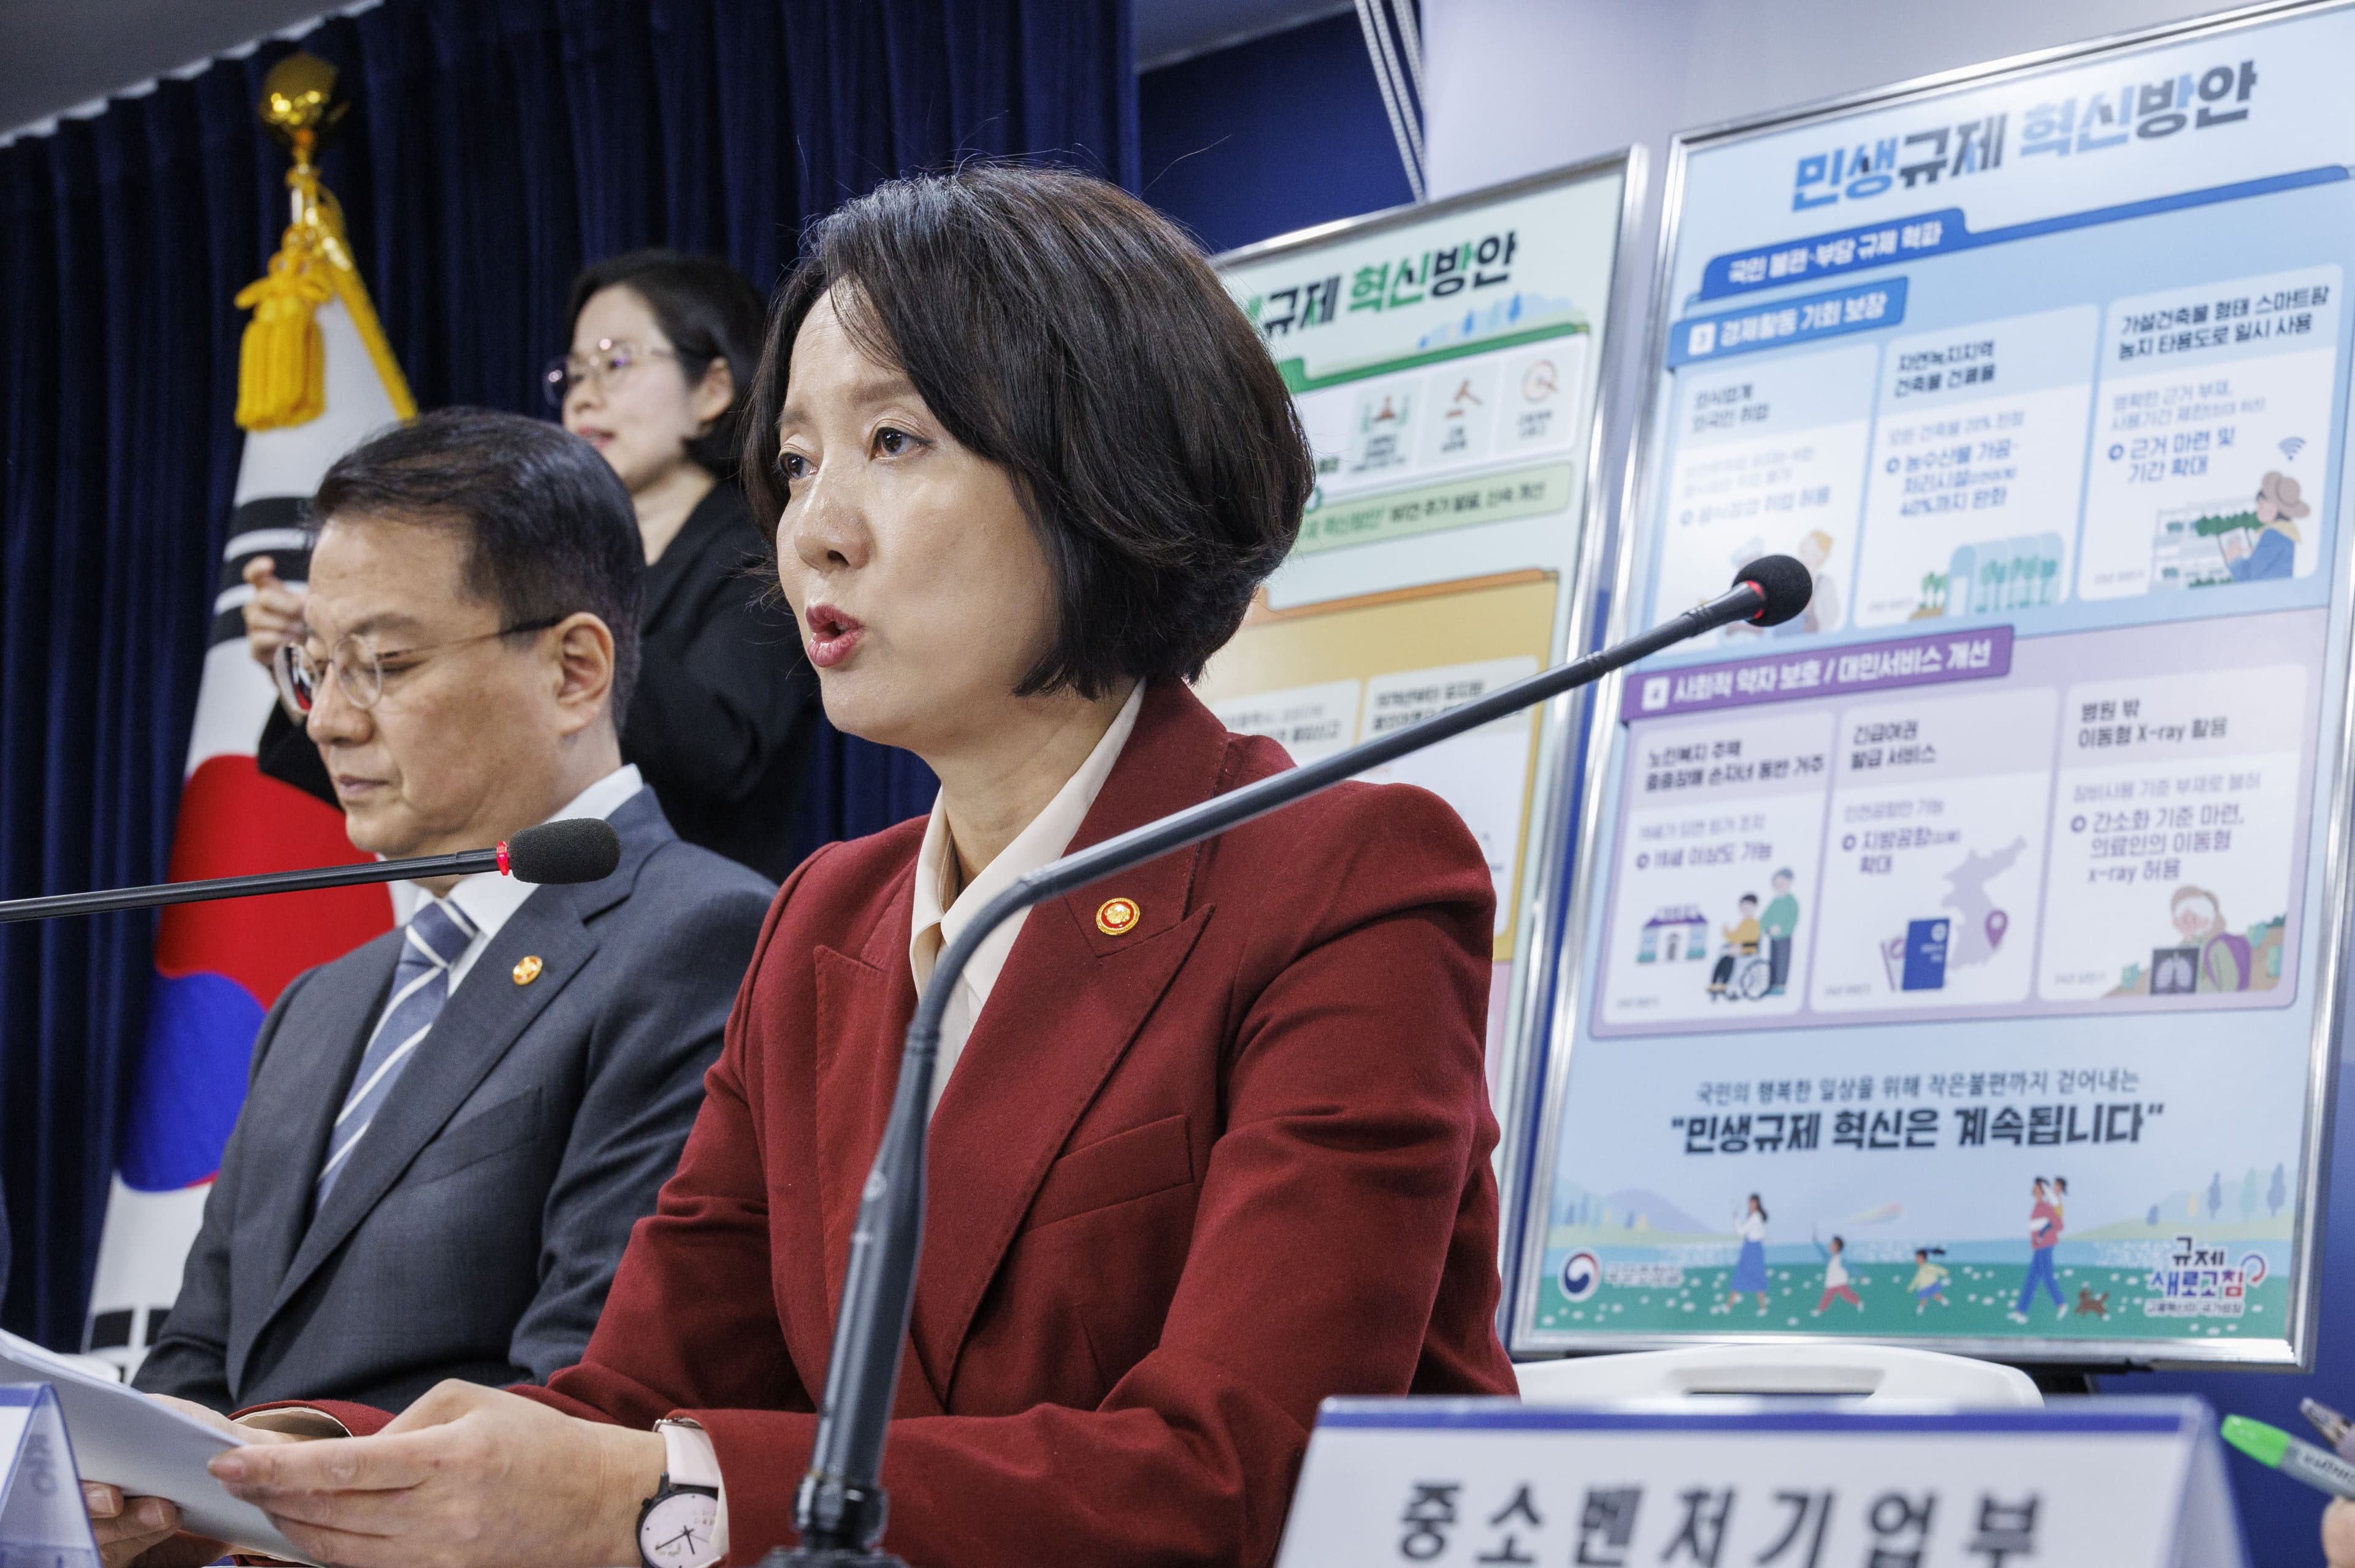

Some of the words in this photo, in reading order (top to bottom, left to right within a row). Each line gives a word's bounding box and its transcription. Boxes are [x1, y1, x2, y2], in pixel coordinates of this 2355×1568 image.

[1791, 113, 2007, 213] 민생규제
[2019, 59, 2257, 157] 혁신방안
[1856, 229, 1897, 259] 규제
[1246, 275, 1342, 337] 규제
[1347, 229, 1518, 313] 혁신방안
[1801, 299, 1842, 331] 기회
[1844, 291, 1888, 323] 보장
[2121, 304, 2210, 335] 가설건축물
[2214, 297, 2250, 321] 형태
[2255, 285, 2330, 315] 스마트팜
[2119, 339, 2154, 361] 농지
[2158, 324, 2229, 355] 타용도로
[2235, 319, 2270, 342] 일시
[2275, 313, 2313, 335] 사용
[1894, 373, 1942, 397] 건축물
[2130, 437, 2167, 459] 근거
[2173, 430, 2210, 454] 마련
[2217, 426, 2235, 447] 및
[2129, 461, 2165, 483] 기간
[2171, 454, 2208, 476] 확대
[1674, 670, 1732, 703] 사회적
[1736, 665, 1777, 694] 약자
[1780, 660, 1820, 690] 보호
[1837, 646, 1943, 682] 대민서비스
[1946, 638, 1992, 668] 개선
[2081, 700, 2116, 723] 병원
[2123, 699, 2140, 717] 밖
[1853, 719, 1918, 745] 긴급여권
[2078, 725, 2131, 748] 이동형
[2136, 724, 2186, 743] X-ray
[2191, 717, 2227, 739] 활용
[1887, 743, 1936, 765] 서비스
[2093, 808, 2150, 833] 간소화
[2155, 805, 2194, 828] 기준
[2090, 833, 2167, 859] 의료인의
[2173, 830, 2231, 852] 이동형
[2088, 866, 2137, 884] x-ray
[2143, 858, 2181, 881] 허용
[1696, 1081, 1750, 1106] 국민의
[1757, 1078, 1811, 1104] 행복한
[1820, 1075, 1874, 1102] 일상을
[1883, 1074, 1921, 1099] 위해
[1928, 1070, 2048, 1098] 작은불편까지
[2057, 1066, 2139, 1095] 걷어내는
[1832, 1107, 1939, 1150] 혁신은
[2173, 1236, 2225, 1266] 규제
[2151, 1270, 2243, 1297] 새로고침
[1397, 1480, 2044, 1568] 중소벤처기업부
